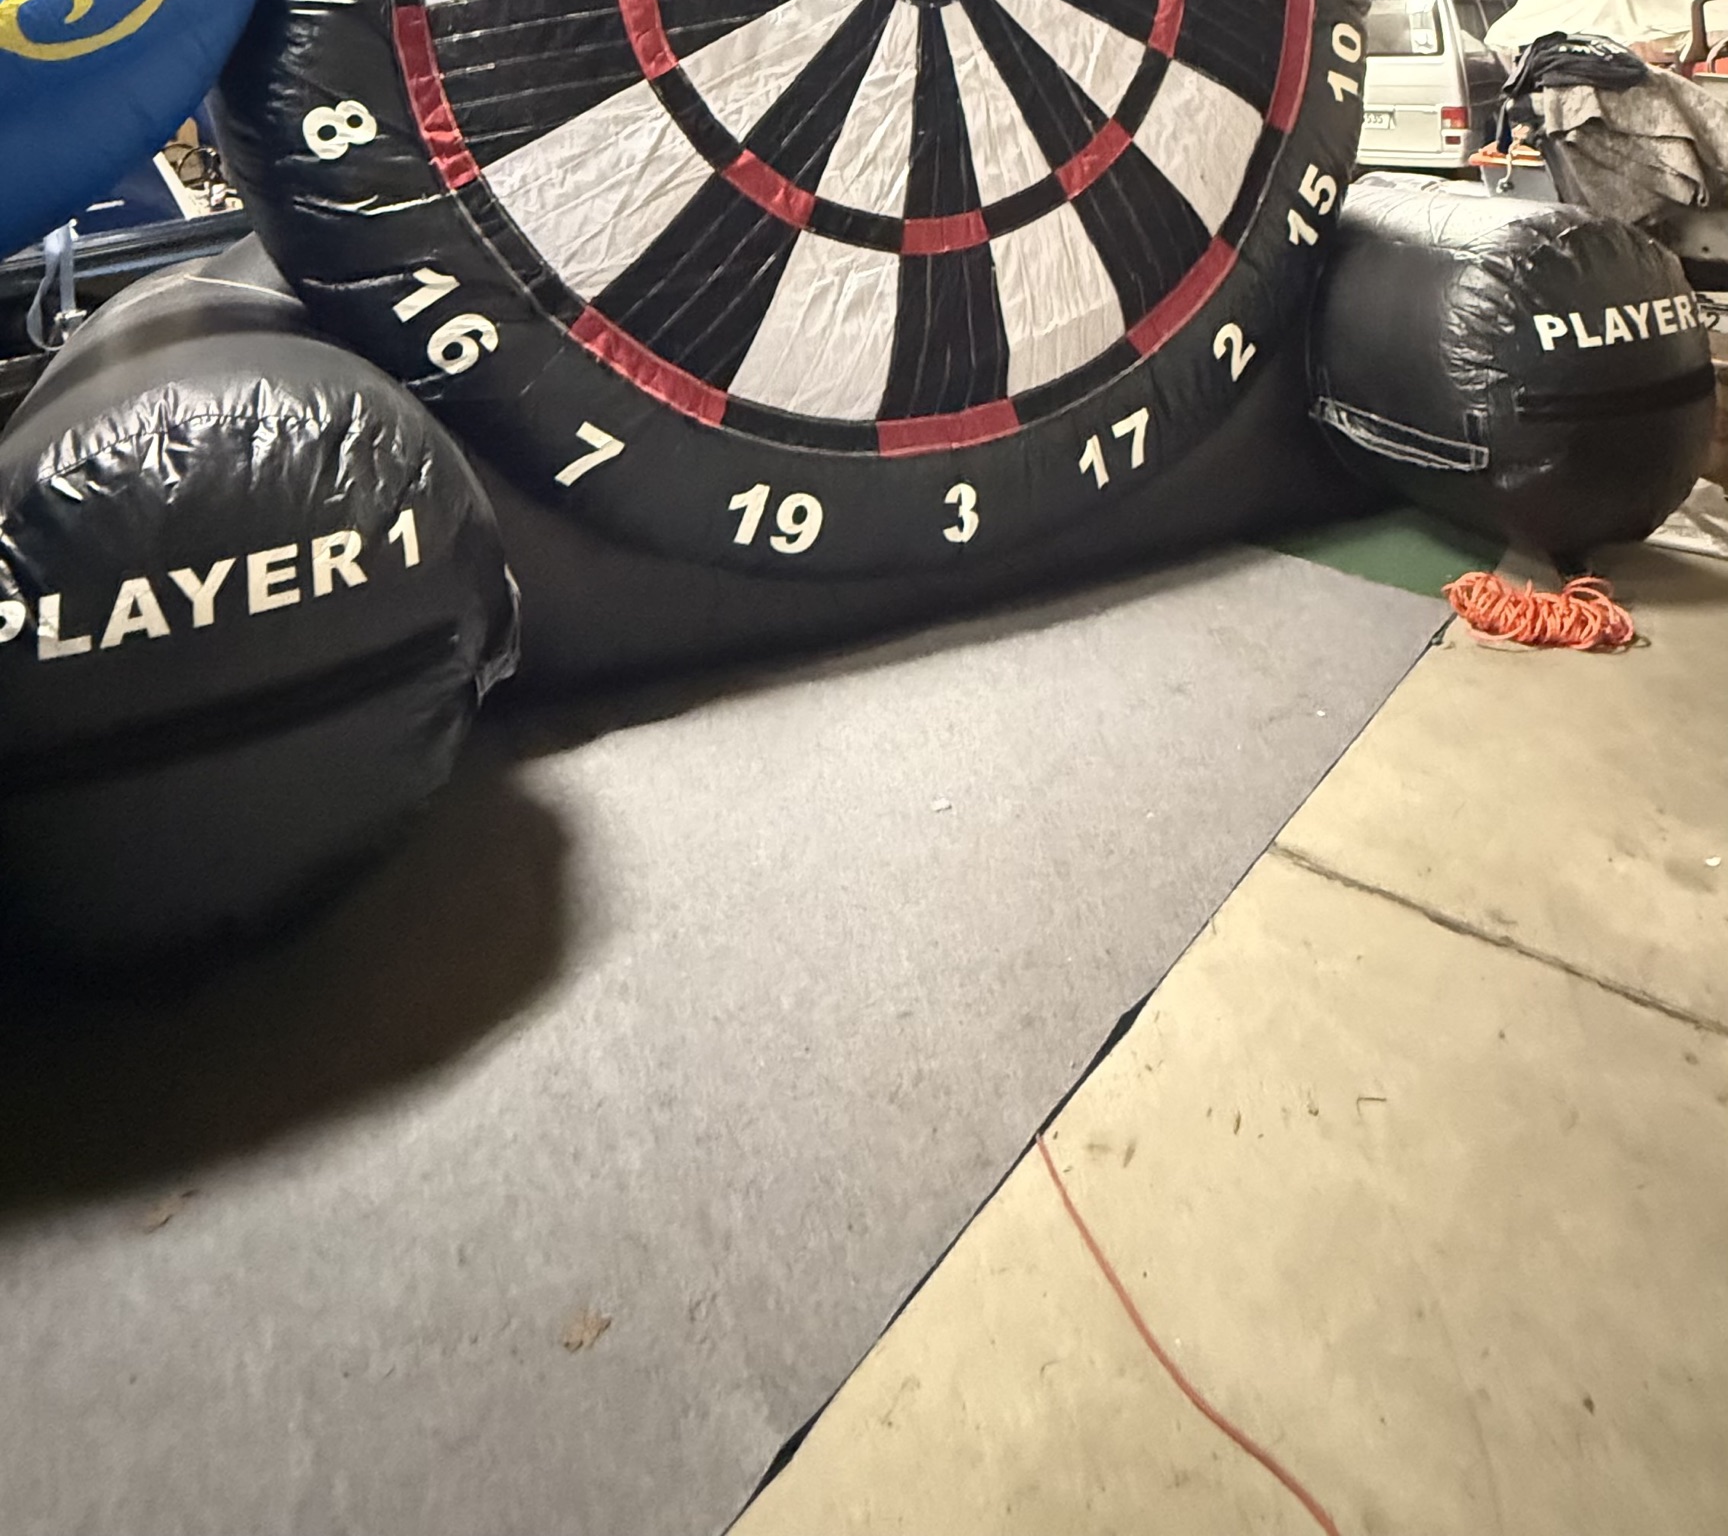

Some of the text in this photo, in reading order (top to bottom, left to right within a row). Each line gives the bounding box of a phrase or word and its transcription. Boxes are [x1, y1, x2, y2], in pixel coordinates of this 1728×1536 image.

[1327, 23, 1361, 103] 10
[303, 100, 377, 160] 8
[1287, 164, 1338, 246] 15
[393, 267, 499, 375] 16
[1213, 322, 1257, 383] 2
[1533, 295, 1697, 351] PLAYER
[554, 421, 625, 487] 7
[1078, 407, 1150, 490] 17
[388, 508, 421, 568] 1
[728, 483, 824, 554] 19
[943, 483, 980, 543] 3
